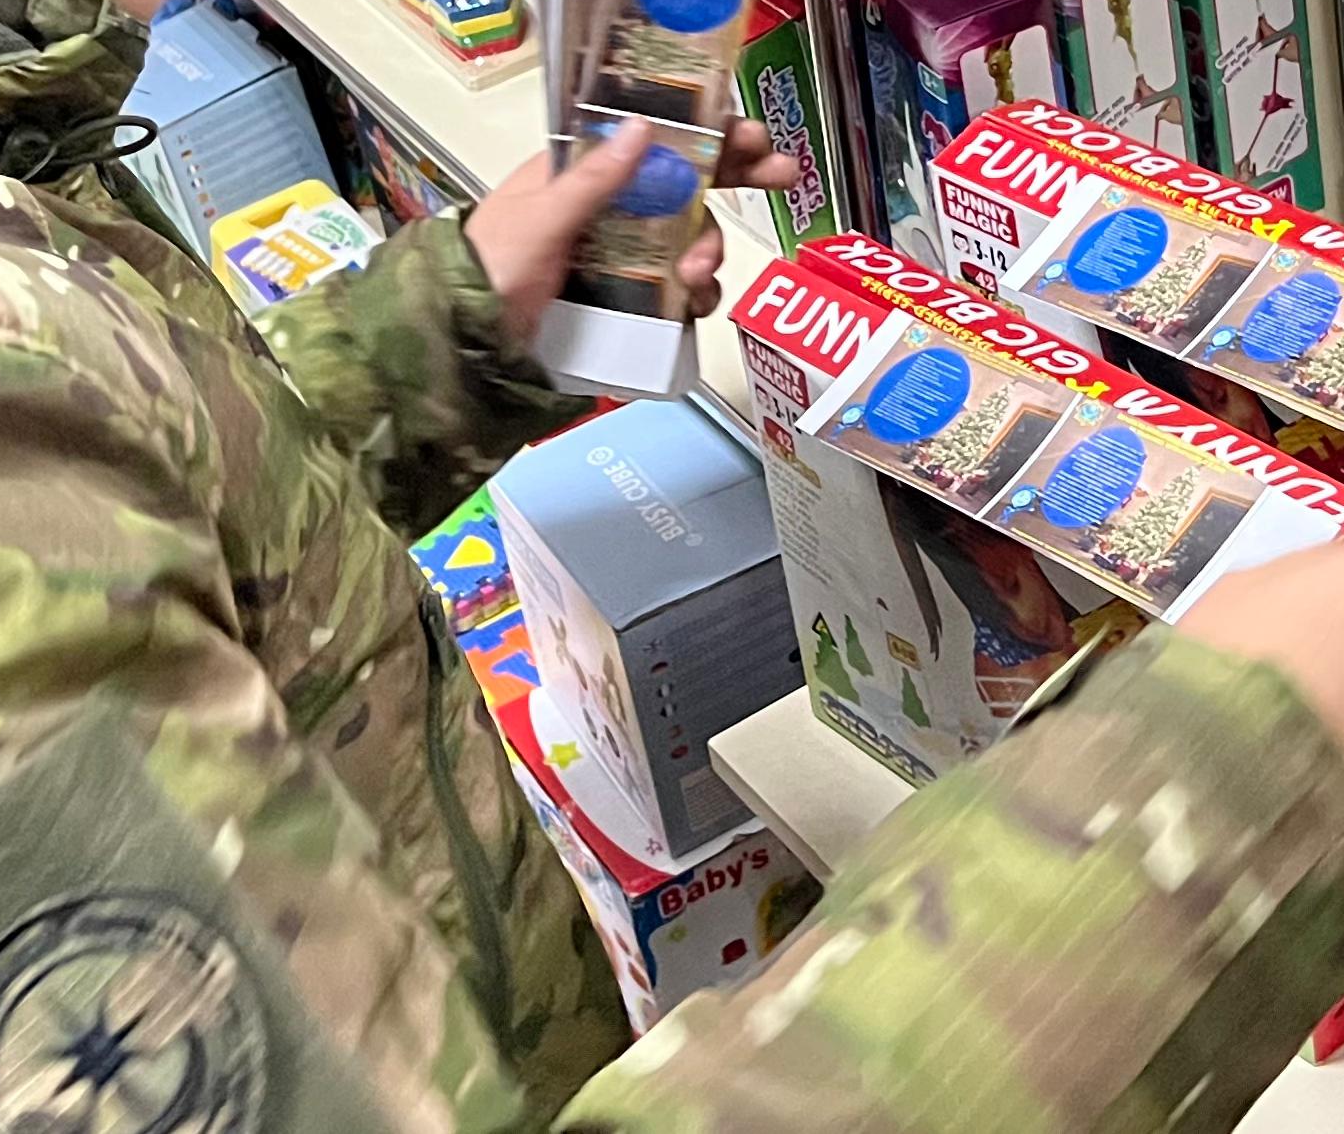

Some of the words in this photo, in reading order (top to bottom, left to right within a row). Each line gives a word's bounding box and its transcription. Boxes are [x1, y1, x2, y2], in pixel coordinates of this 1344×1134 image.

[1008, 105, 1180, 178] BLOCK
[956, 131, 1080, 215] FUNN
[944, 182, 1011, 226] FUNNY
[947, 199, 1014, 243] MAGIC
[825, 238, 998, 325] BLOCK
[974, 240, 1008, 273] 3-12
[975, 271, 997, 292] 42
[748, 275, 876, 364] FUNN
[745, 335, 801, 386] FUNNY
[749, 352, 805, 404] MAGIC
[600, 458, 647, 506] CUBE
[641, 499, 686, 547] BUSY
[659, 846, 770, 917] Baby's
